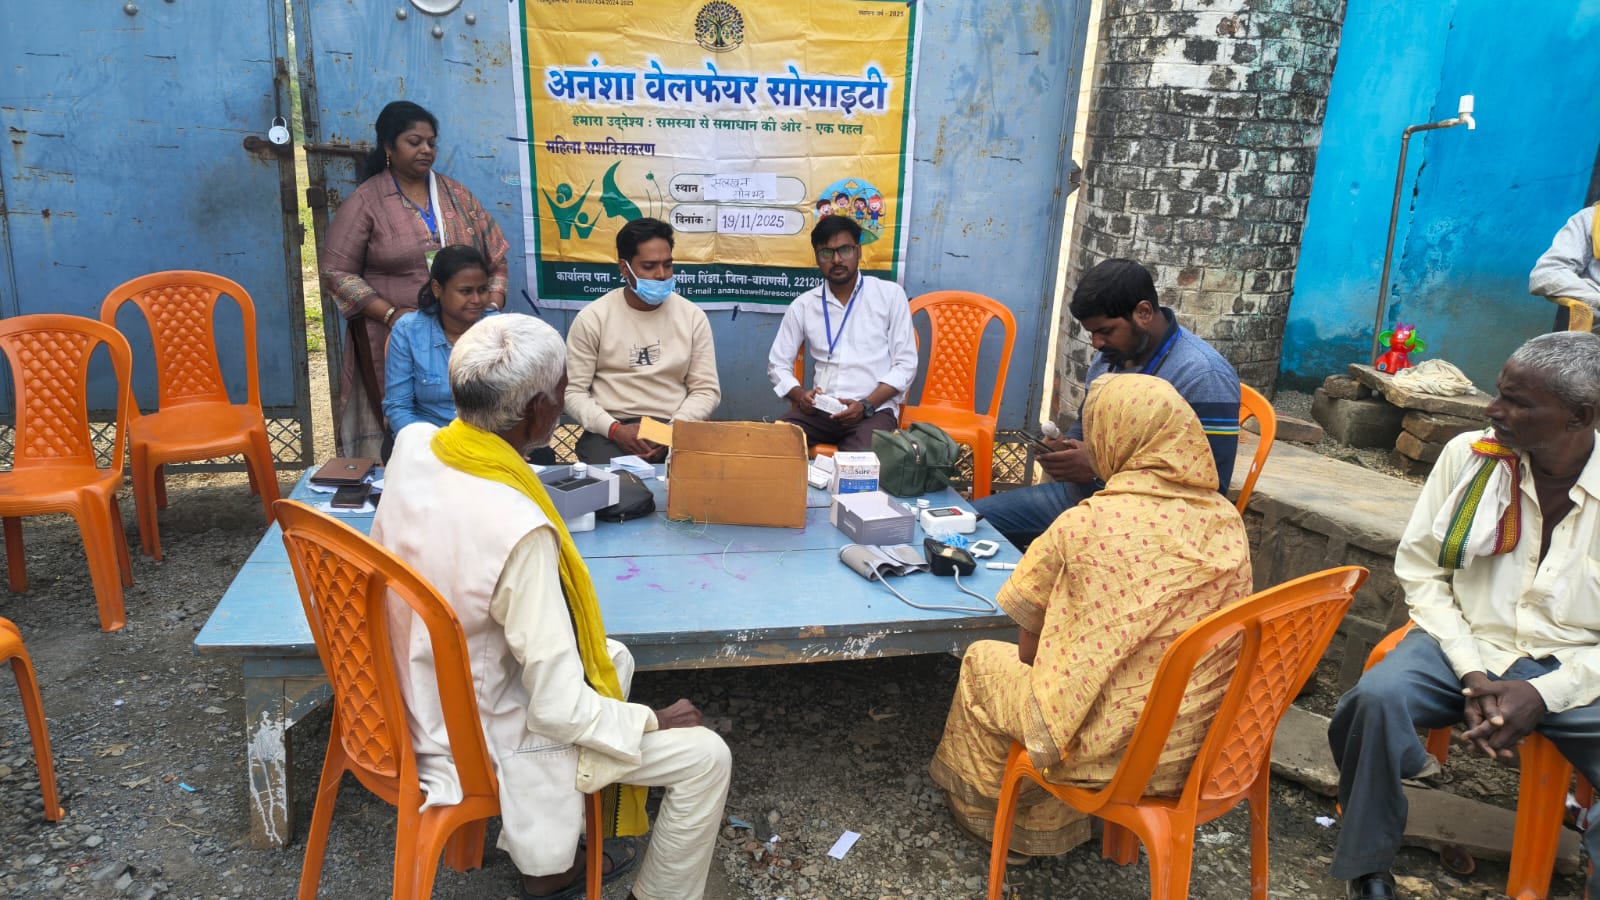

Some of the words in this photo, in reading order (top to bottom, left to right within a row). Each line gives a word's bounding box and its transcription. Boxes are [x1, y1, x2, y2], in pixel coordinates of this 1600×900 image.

[548, 59, 635, 101] अनंशा
[644, 60, 758, 104] वेलफेयर
[766, 65, 888, 114] सोसाइटी
[572, 115, 603, 127] हमारा
[656, 117, 695, 128] समस्या
[699, 114, 710, 129] से
[712, 118, 757, 131] समाधान
[761, 116, 777, 132] की
[780, 117, 803, 132] ओर
[815, 122, 834, 135] एक
[838, 124, 863, 136] पहल
[545, 135, 581, 155] महिला
[675, 182, 698, 193] स्थान
[675, 210, 704, 225] दिनांक
[721, 211, 785, 231] 19/11/2025
[556, 267, 592, 282] कार्यालय
[593, 272, 610, 282] पता
[584, 285, 613, 293] Contac
[687, 287, 712, 295] E-mail
